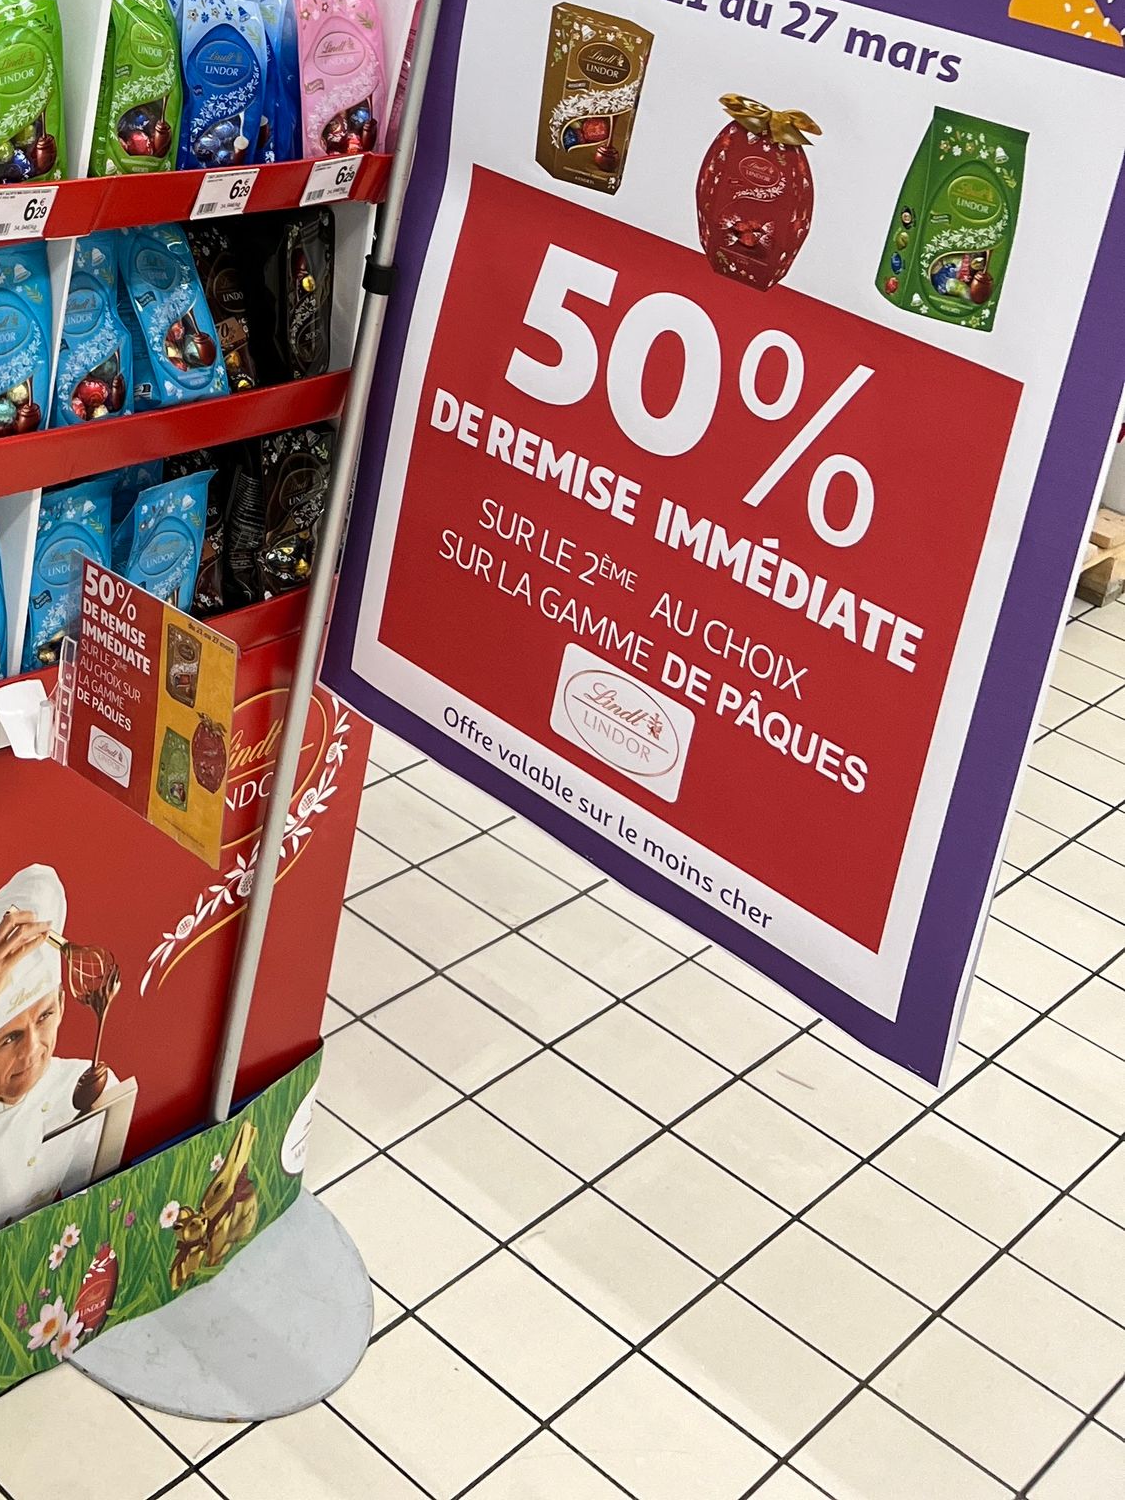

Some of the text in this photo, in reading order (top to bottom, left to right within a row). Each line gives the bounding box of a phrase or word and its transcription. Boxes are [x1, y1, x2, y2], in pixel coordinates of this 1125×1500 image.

[779, 1, 839, 46] 27
[844, 29, 963, 84] mars
[205, 65, 239, 77] LINDOR
[586, 63, 619, 79] LINDOR
[504, 242, 877, 549] 50%
[429, 387, 925, 672] DE REMISE IMMÉDIATE
[85, 564, 137, 622] 50%
[478, 498, 535, 551] SUR
[534, 526, 574, 569] LE
[650, 591, 698, 638] AU
[704, 617, 811, 700] CHOIX
[82, 619, 151, 676] IMMÉDIATE
[83, 599, 146, 650] DE REMISE
[80, 657, 141, 704] AU CHOIX SUR
[81, 639, 111, 667] SUR LE
[438, 529, 869, 794] SUR LA GAMME DE PÂQUES
[77, 686, 132, 732] DE PÂQUES
[78, 670, 125, 711] LA GAMME
[583, 678, 651, 732] Lindt
[581, 709, 653, 765] LINDOR
[442, 705, 774, 931] Offre valable sur le moins cher
